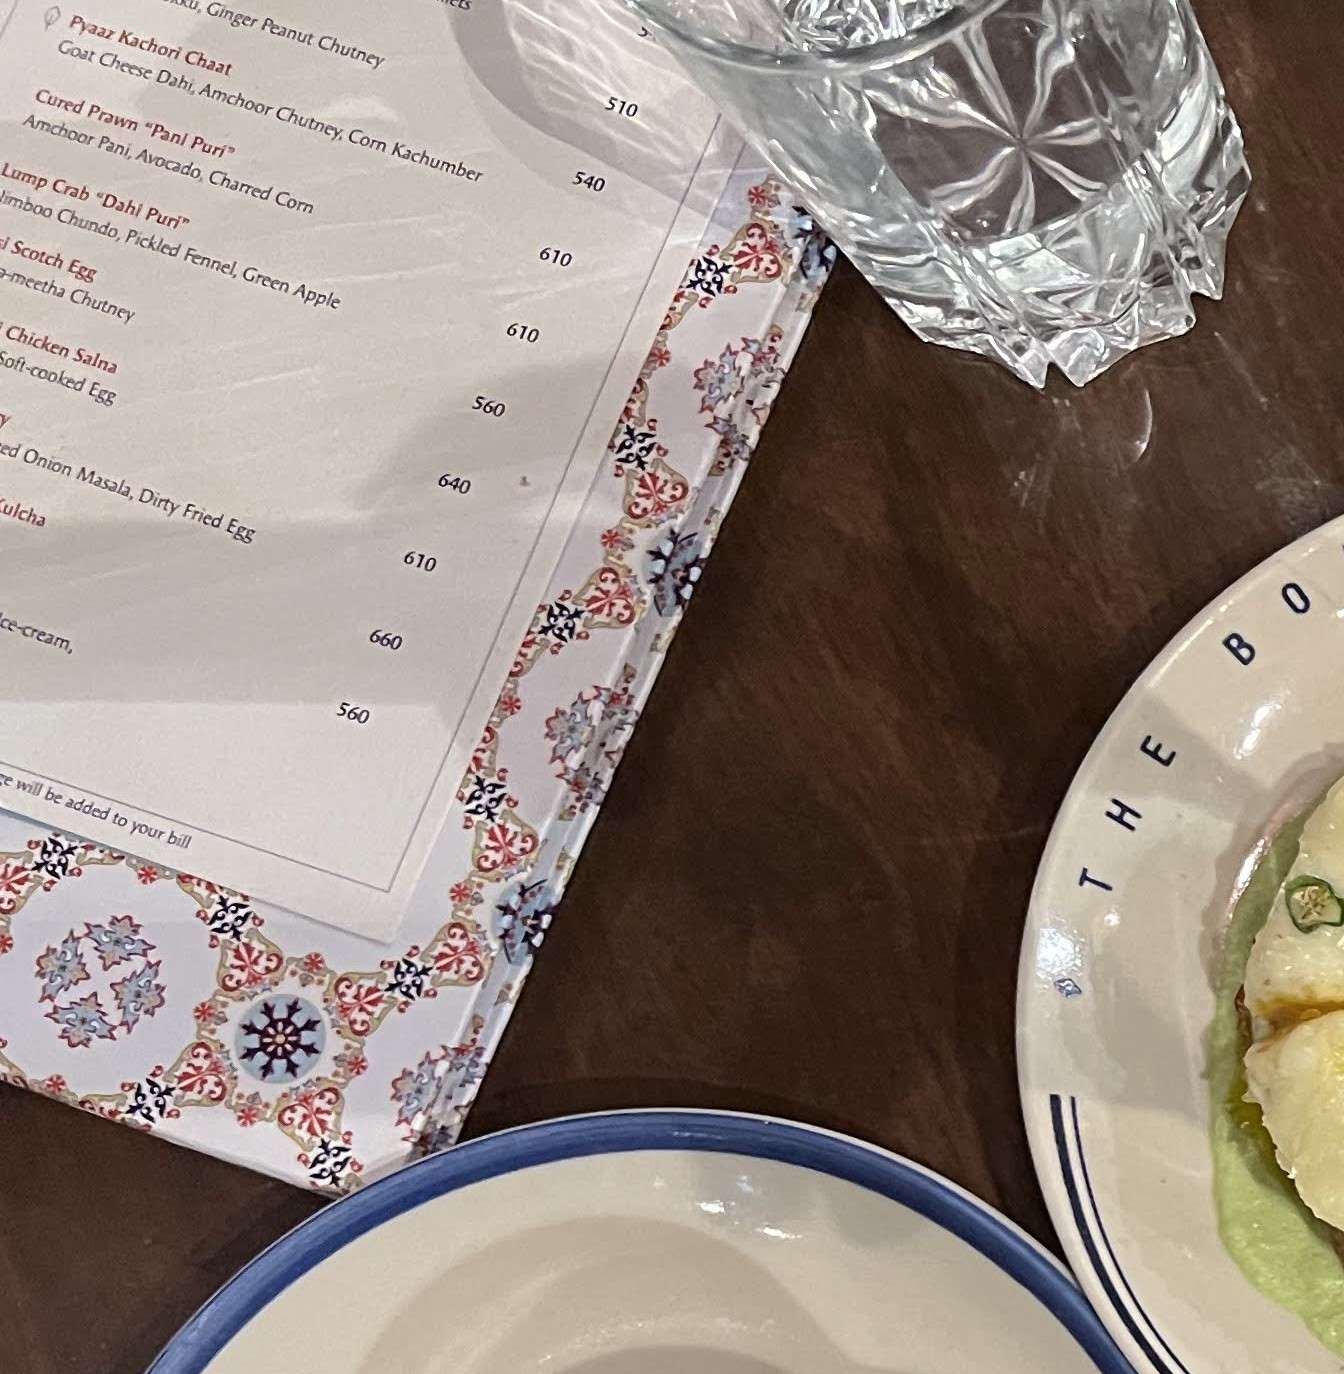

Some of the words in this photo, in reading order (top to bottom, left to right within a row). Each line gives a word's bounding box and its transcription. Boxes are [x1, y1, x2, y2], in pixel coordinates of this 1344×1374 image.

[70, 15, 115, 36] Pyaaz
[118, 29, 183, 60] Kachori
[185, 50, 233, 77] Chaat
[206, 2, 258, 28] Ginger
[261, 17, 314, 46] Peanut
[318, 35, 386, 69] Chutney
[35, 88, 85, 114] Cured
[87, 103, 138, 132] Prawn
[58, 39, 95, 62] Goat
[99, 52, 153, 80] Cheese
[156, 69, 195, 95] Dahi,
[199, 82, 274, 117] Amchoor
[276, 106, 343, 142] Chutney,
[348, 128, 387, 153] Corn
[391, 141, 484, 183] Kachumber
[604, 96, 639, 119] 510
[1, 162, 48, 191] Lump
[52, 178, 90, 201] Crab
[22, 114, 96, 146] Amchoor
[97, 135, 132, 160] Pani,
[135, 148, 203, 183] Avocado,
[209, 170, 273, 202] Charred
[275, 191, 315, 216] Corn
[572, 171, 606, 193] 540
[11, 240, 64, 269] Scotch
[68, 259, 98, 284] Egg
[57, 208, 121, 242] Chundo,
[125, 229, 182, 258] Pickled
[184, 247, 238, 278] Fennel,
[242, 266, 290, 294] Green
[292, 282, 342, 309] Apple
[538, 247, 573, 268] 610
[69, 288, 136, 325] Chutney
[5, 325, 70, 359] Chicken
[73, 348, 118, 374] Salna
[506, 322, 540, 344] 610
[89, 381, 117, 407] Egg
[471, 394, 506, 418] 560
[23, 448, 72, 477] Onion
[76, 466, 134, 501] Masala,
[138, 488, 180, 517] Dirty
[182, 503, 225, 529] Fried
[226, 518, 257, 545] Egg
[437, 472, 471, 495] 640
[403, 550, 437, 573] 610
[369, 628, 403, 652] 660
[336, 701, 370, 725] 560
[17, 780, 43, 797] will
[44, 786, 64, 805] be
[65, 798, 111, 821] added
[112, 812, 128, 828] to
[130, 821, 165, 840] your
[167, 830, 193, 849] bill
[1076, 734, 1178, 893] THE
